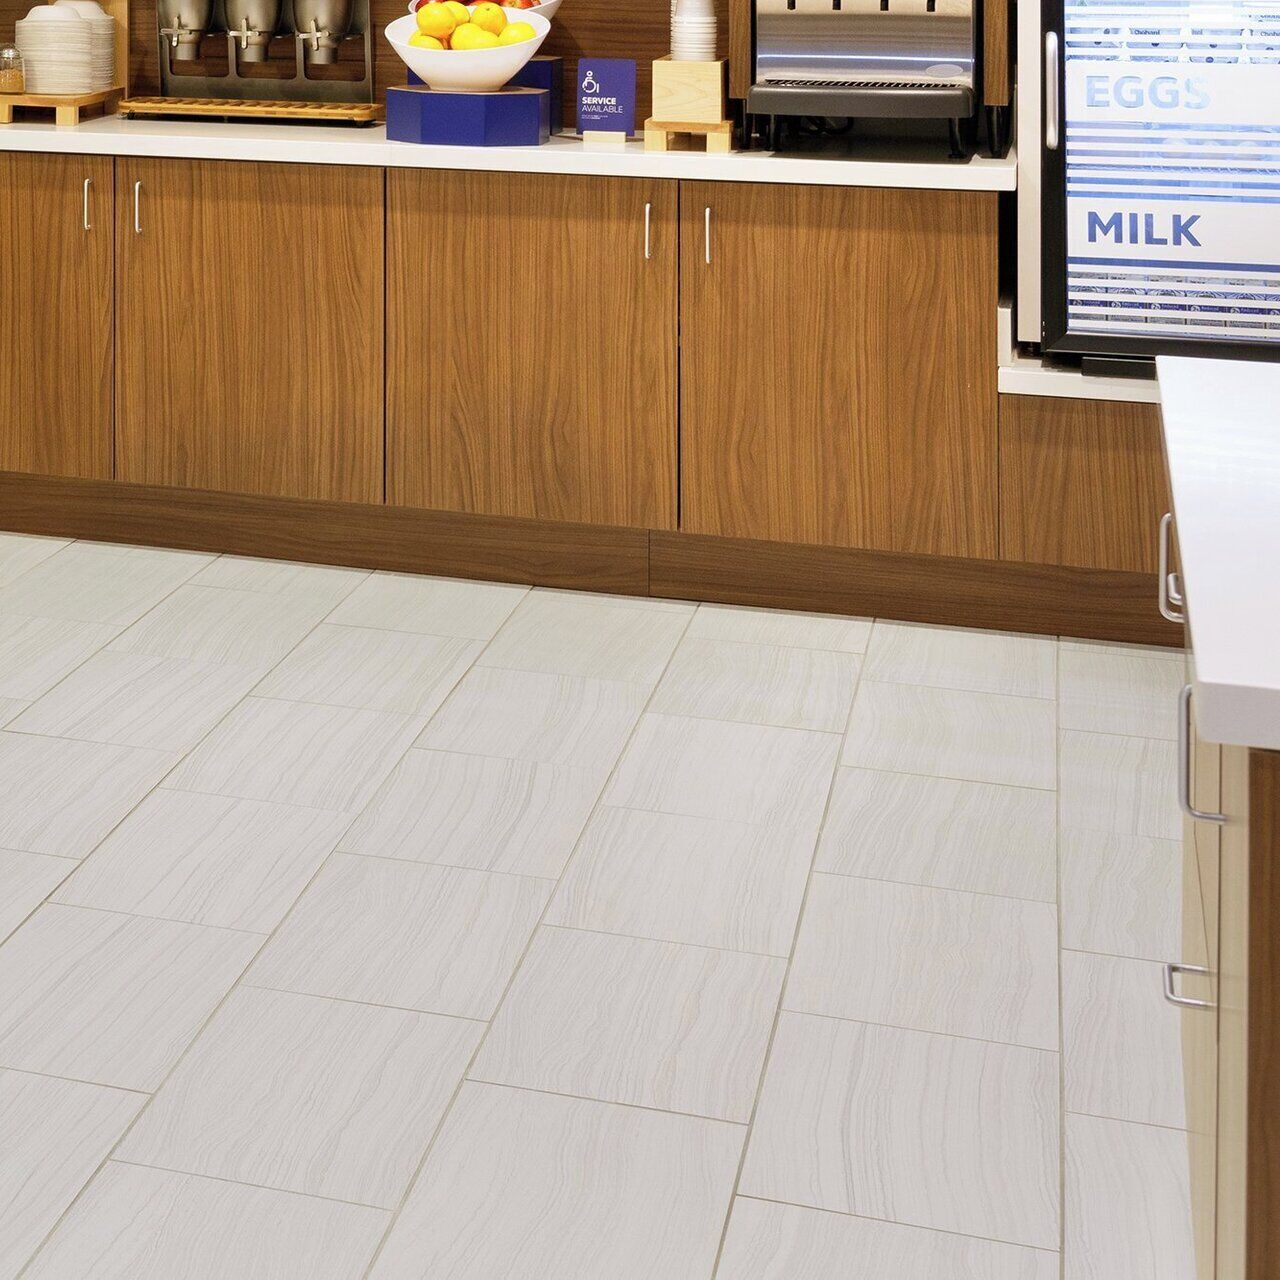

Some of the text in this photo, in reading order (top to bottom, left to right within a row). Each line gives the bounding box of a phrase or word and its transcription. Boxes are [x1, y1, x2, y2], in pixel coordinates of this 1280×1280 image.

[581, 97, 617, 105] SERVICE
[1086, 76, 1211, 109] EGGS
[581, 105, 624, 114] AVAILABLE
[1088, 211, 1202, 247] MILK
